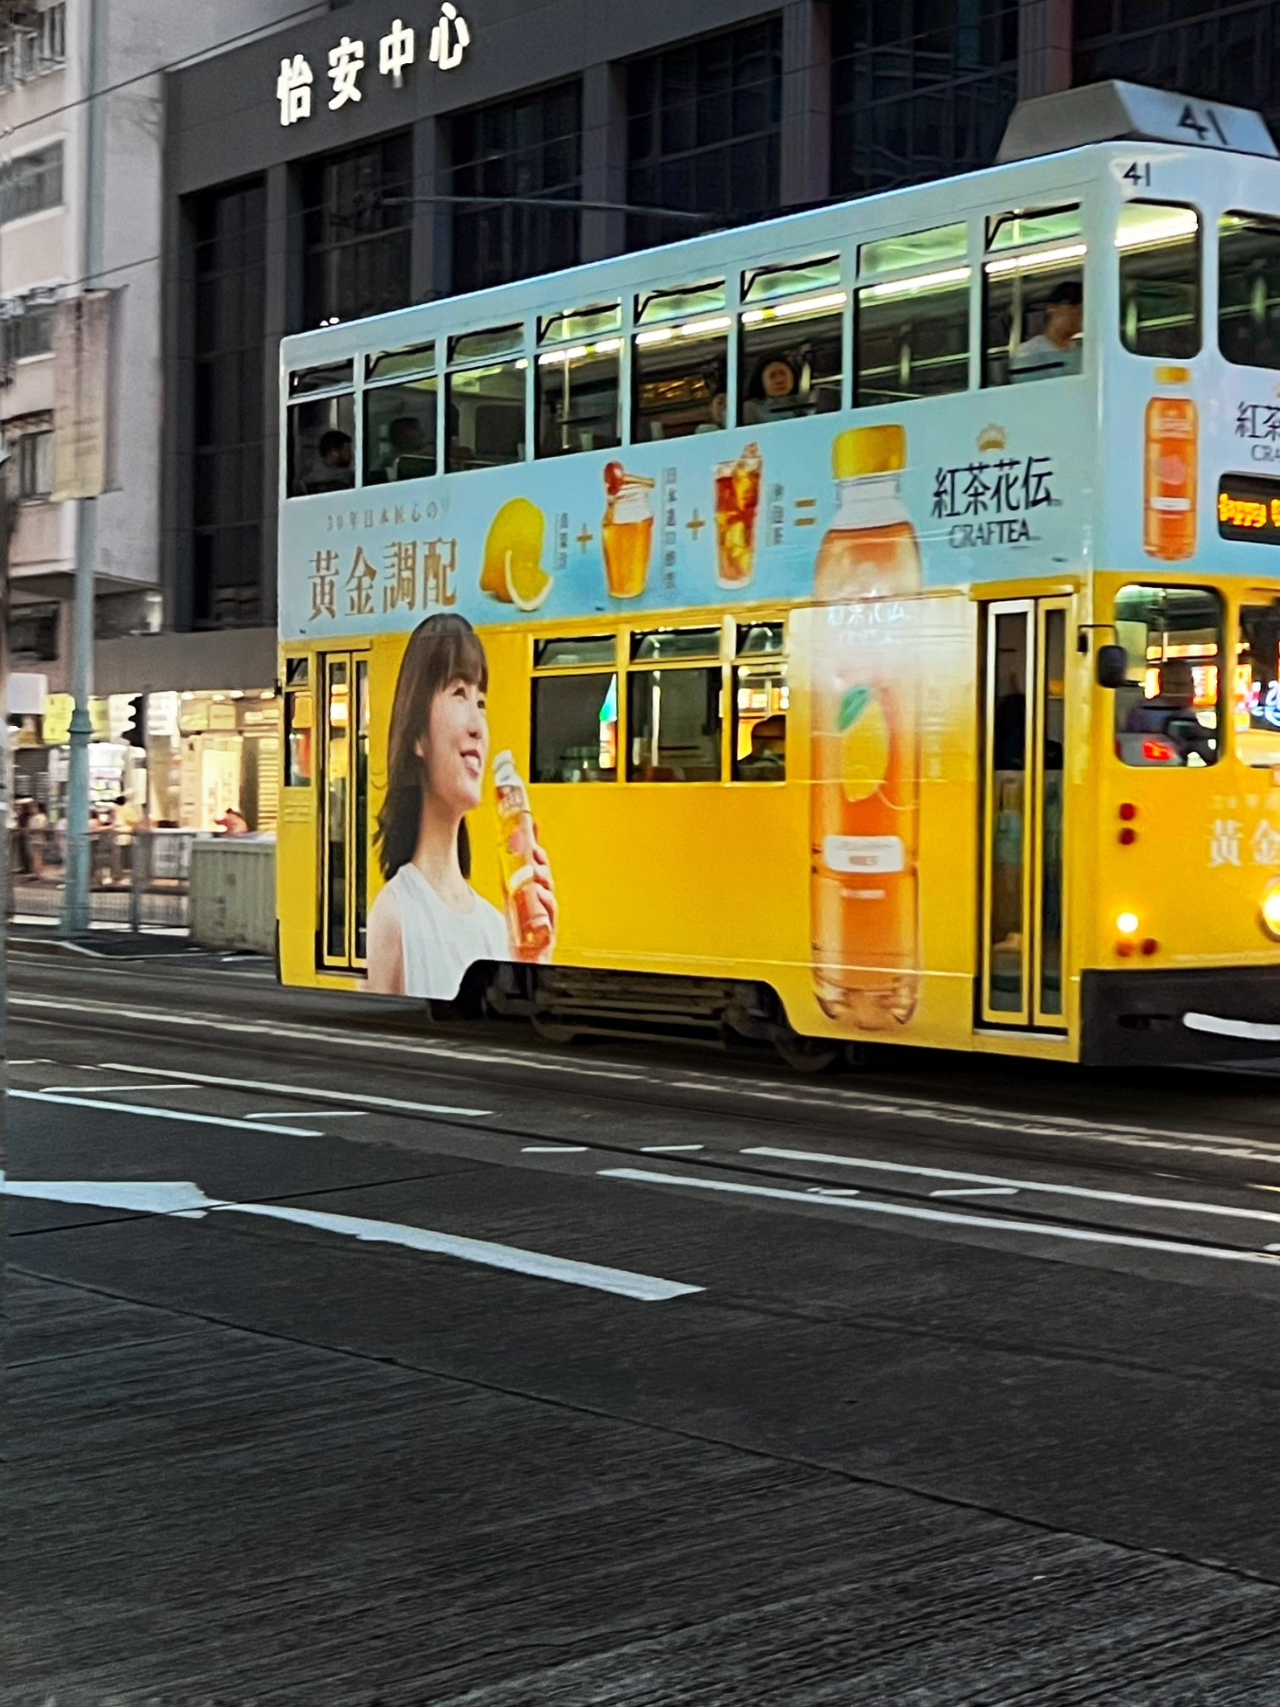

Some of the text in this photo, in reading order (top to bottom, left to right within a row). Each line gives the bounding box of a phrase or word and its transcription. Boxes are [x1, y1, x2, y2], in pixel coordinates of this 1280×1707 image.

[277, 2, 470, 127] 怡安中心
[1176, 103, 1230, 146] 41
[1122, 161, 1151, 188] 41
[931, 456, 1055, 519] 紅茶花伝
[948, 518, 1031, 549] CRAFTEA
